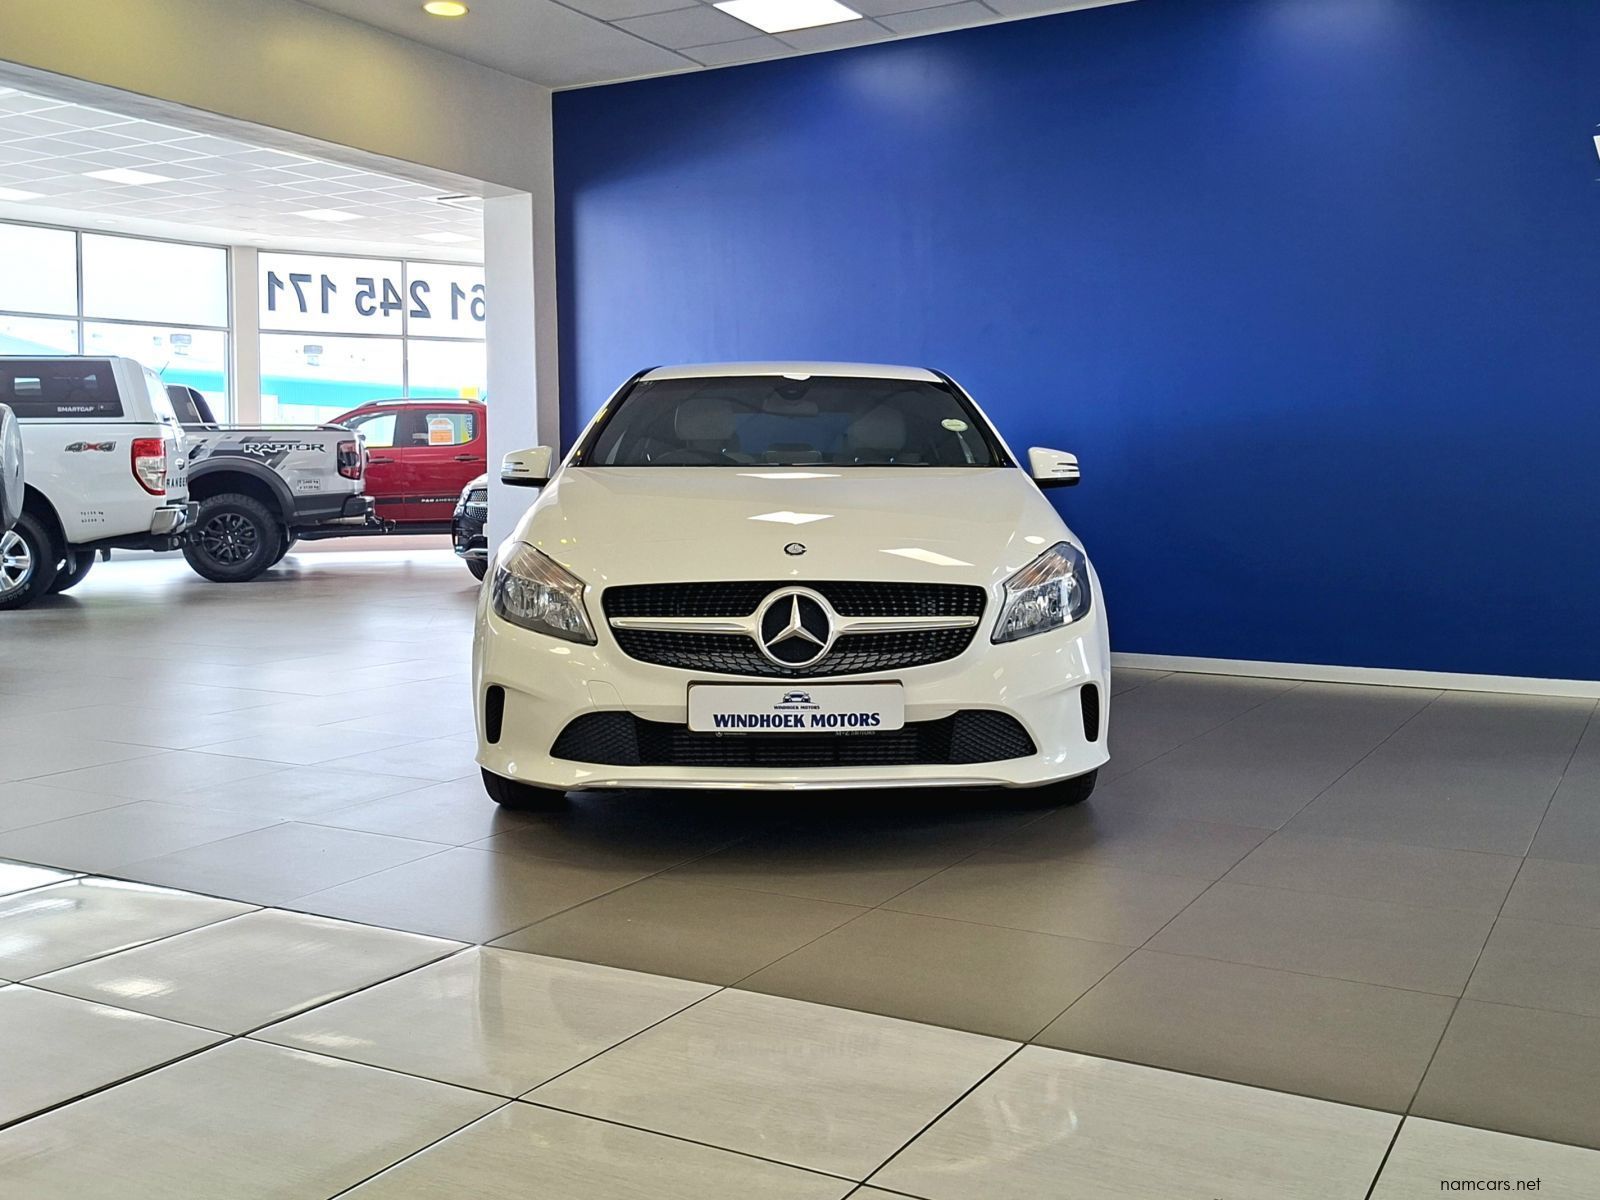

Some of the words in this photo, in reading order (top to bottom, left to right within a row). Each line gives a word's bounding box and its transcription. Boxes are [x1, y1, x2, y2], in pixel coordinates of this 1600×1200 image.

[243, 442, 326, 456] RAPTOR
[713, 713, 805, 728] WINDHOEK
[810, 712, 880, 728] MOTORS
